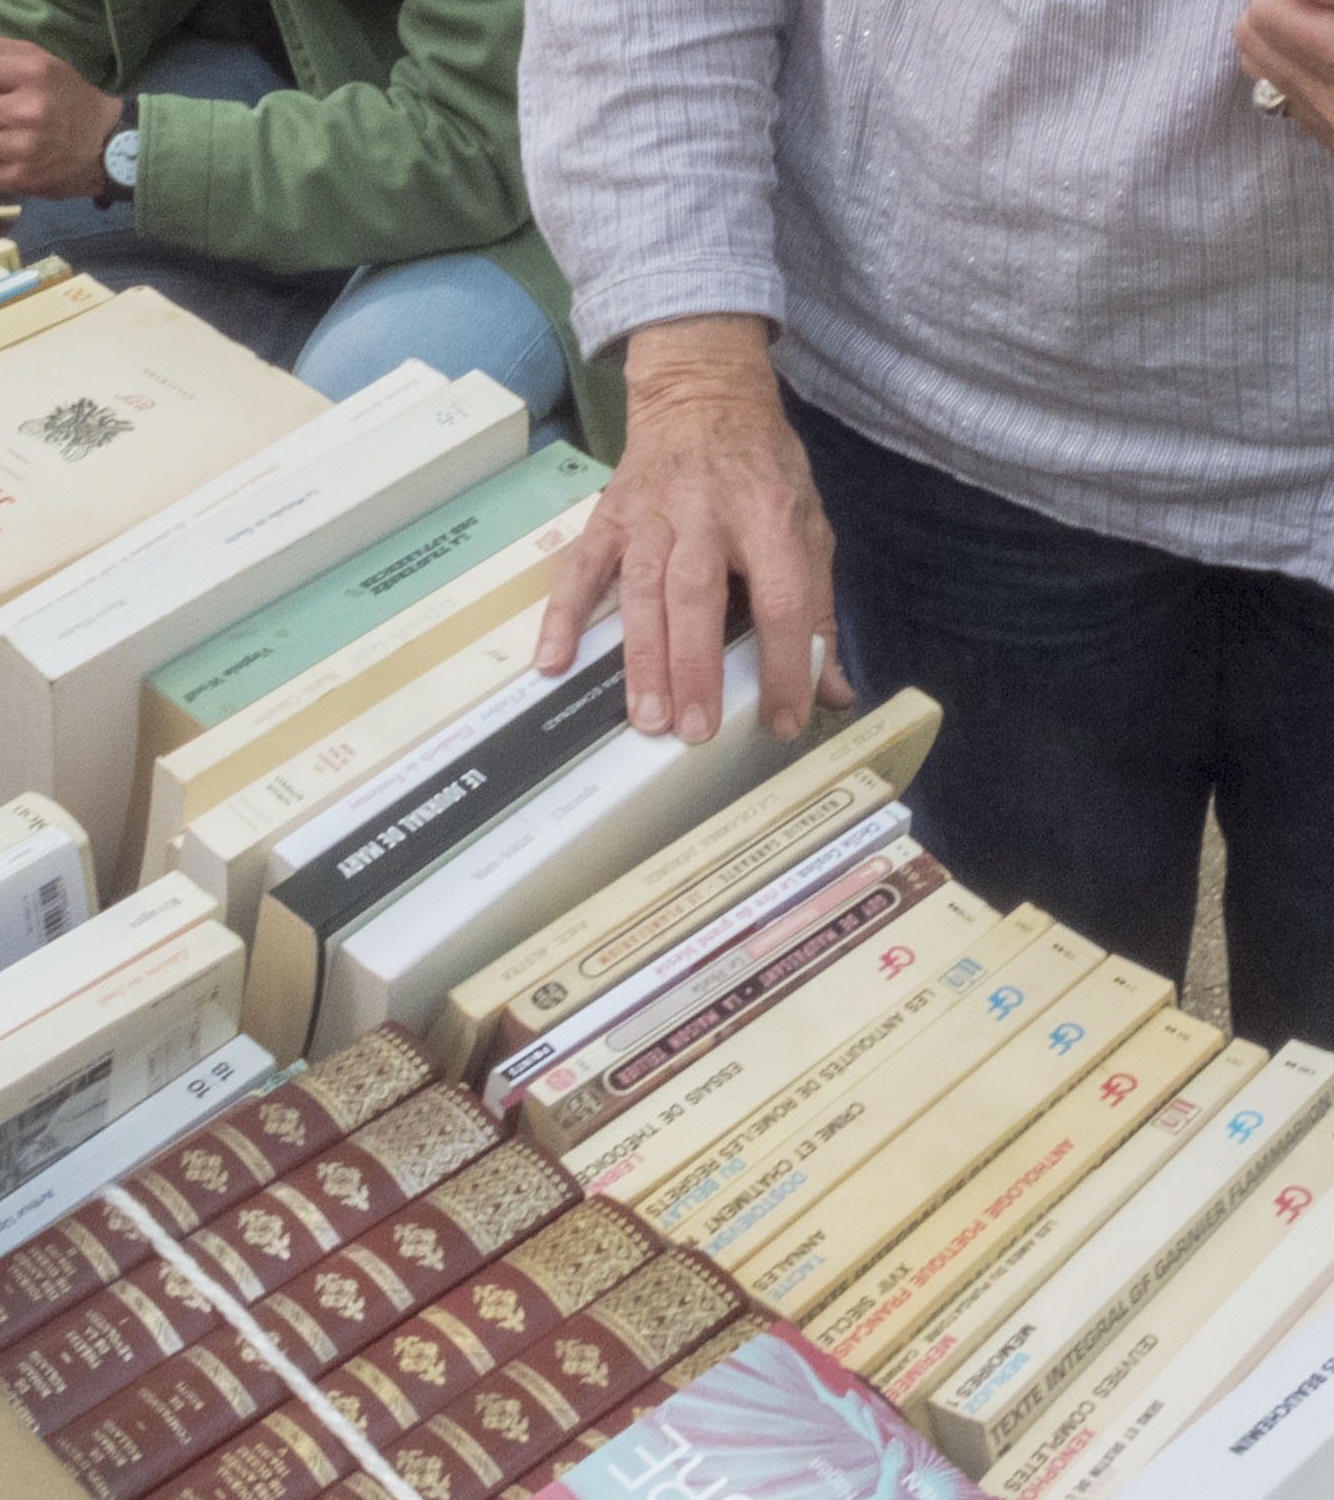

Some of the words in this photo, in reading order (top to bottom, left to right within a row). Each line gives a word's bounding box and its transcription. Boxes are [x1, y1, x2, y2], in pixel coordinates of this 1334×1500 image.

[221, 642, 274, 679] Virginia
[180, 672, 225, 705] Woolf
[458, 765, 487, 792] LE
[395, 779, 467, 837] JOURNAL
[335, 837, 385, 880] MARY
[374, 822, 405, 852] DE
[836, 910, 860, 934] DE
[859, 890, 888, 918] GUY
[756, 924, 839, 989] MAUPASSANT
[903, 985, 936, 1015] LES
[987, 985, 1024, 1021] GF
[665, 1007, 720, 1052] MAISON
[1048, 1021, 1085, 1056] GF
[615, 1043, 667, 1087] TELLIER
[683, 1059, 742, 1107] ESSAIS
[796, 1076, 821, 1099] DE
[1099, 1071, 1138, 1108] GF
[657, 1101, 684, 1127] DE
[815, 1097, 867, 1143] CRIME
[1226, 1109, 1264, 1144] GF
[792, 1137, 818, 1162] ET
[644, 1156, 721, 1220] REGRETS
[982, 1135, 1075, 1221] ANTHOLOGIE
[1273, 1185, 1313, 1224] GF
[751, 1229, 827, 1294] ANNALES
[908, 1215, 987, 1290] POETIQUE
[766, 1250, 827, 1303] TACITE
[816, 1292, 876, 1348] SIECLE
[990, 1384, 1047, 1443] TEXTE
[1038, 1297, 1132, 1392] INTEGRAL
[1123, 1277, 1151, 1306] GF
[1147, 1198, 1230, 1282] GARNIER
[955, 1320, 1037, 1401] MEMOIRES
[1226, 1368, 1326, 1460] BEAUCHEMIN
[1000, 1396, 1097, 1496] COMPLETES
